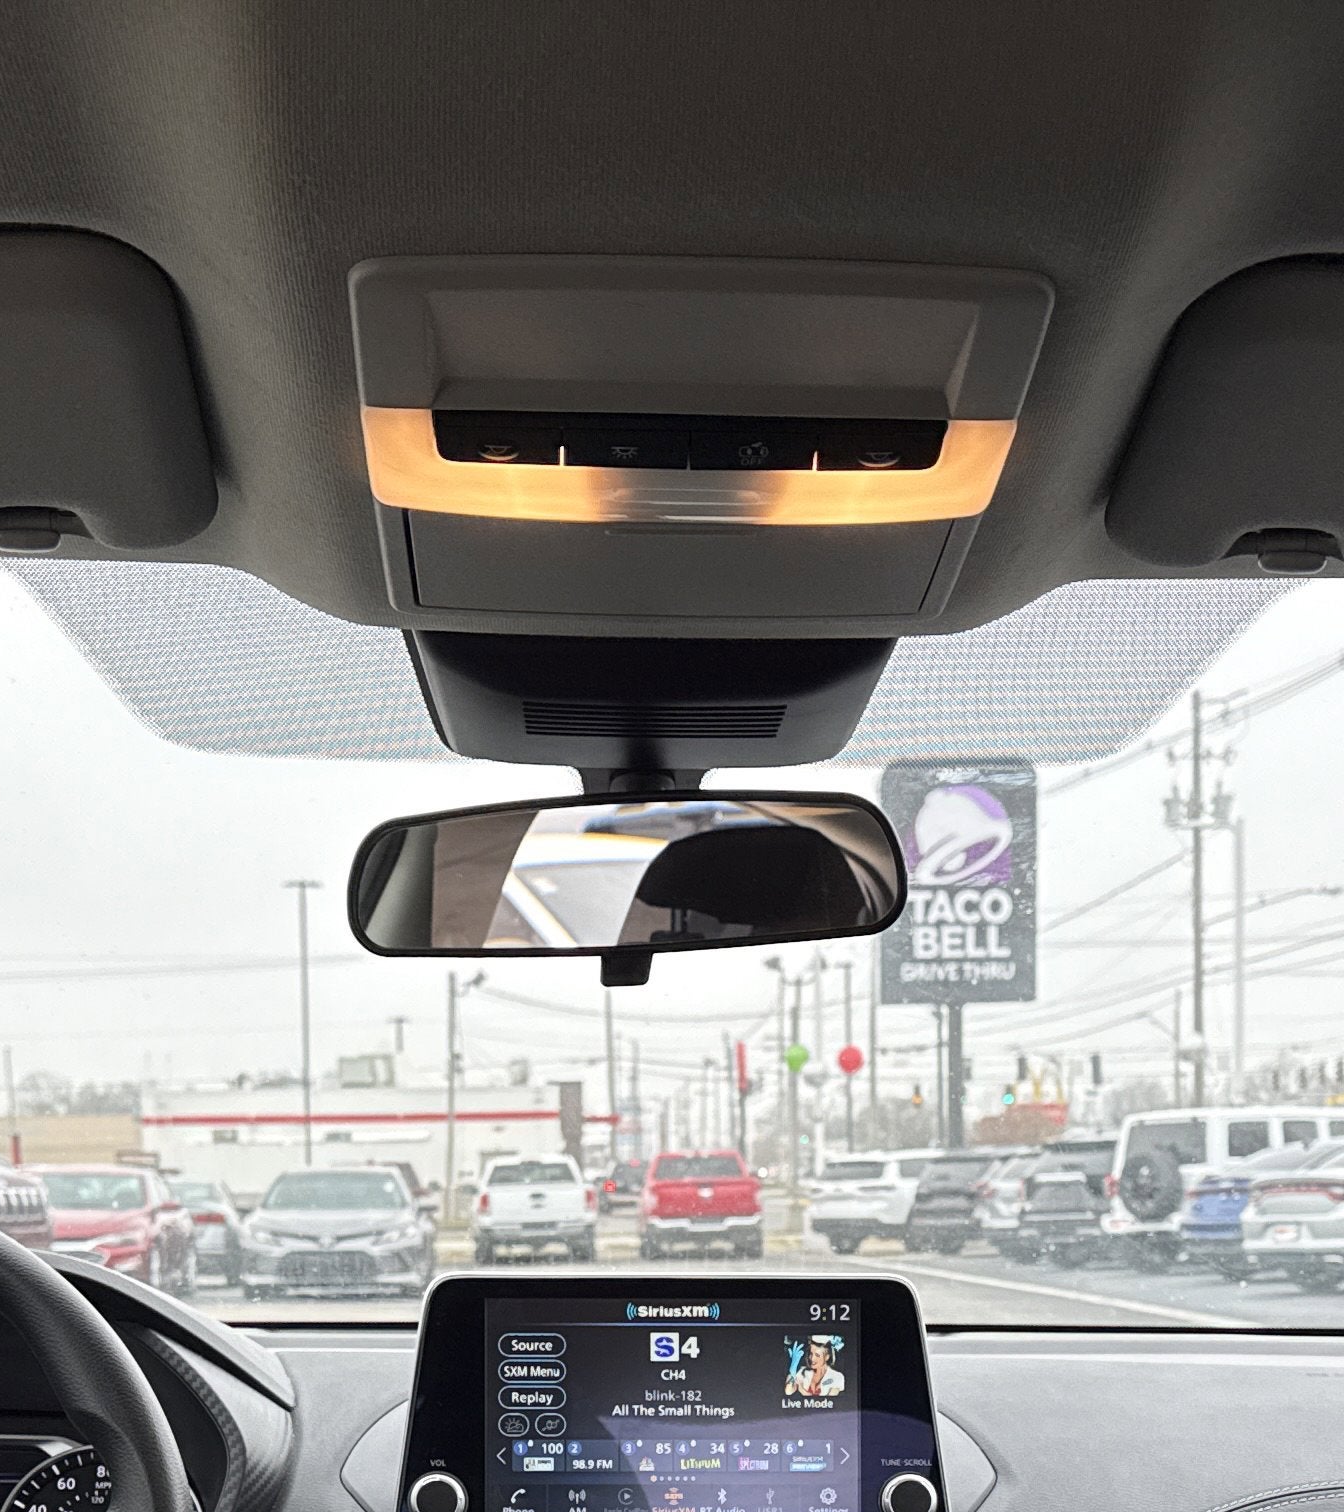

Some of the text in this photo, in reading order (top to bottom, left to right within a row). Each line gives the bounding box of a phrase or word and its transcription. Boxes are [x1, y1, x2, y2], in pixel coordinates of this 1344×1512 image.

[908, 888, 1013, 925] TACO
[912, 925, 1011, 959] BELL
[900, 960, 1016, 982] DRIVE THRU
[637, 1305, 709, 1318] SiriusXM
[809, 1304, 850, 1321] 9:12
[511, 1340, 553, 1352] Source
[680, 1336, 700, 1359] 4
[503, 1366, 560, 1378] SXM Menu
[660, 1369, 687, 1381] CH4
[511, 1392, 554, 1405] Replay
[644, 1390, 702, 1402] blink-182
[781, 1398, 834, 1410] Live Mode
[612, 1404, 735, 1420] All The Small Things
[541, 1442, 564, 1455] 100
[655, 1442, 672, 1455] 85
[709, 1442, 726, 1455] 34
[763, 1442, 779, 1455] 28
[429, 1459, 447, 1468] VOL
[572, 1459, 613, 1470] 98.9 FM
[57, 1477, 76, 1490] 60
